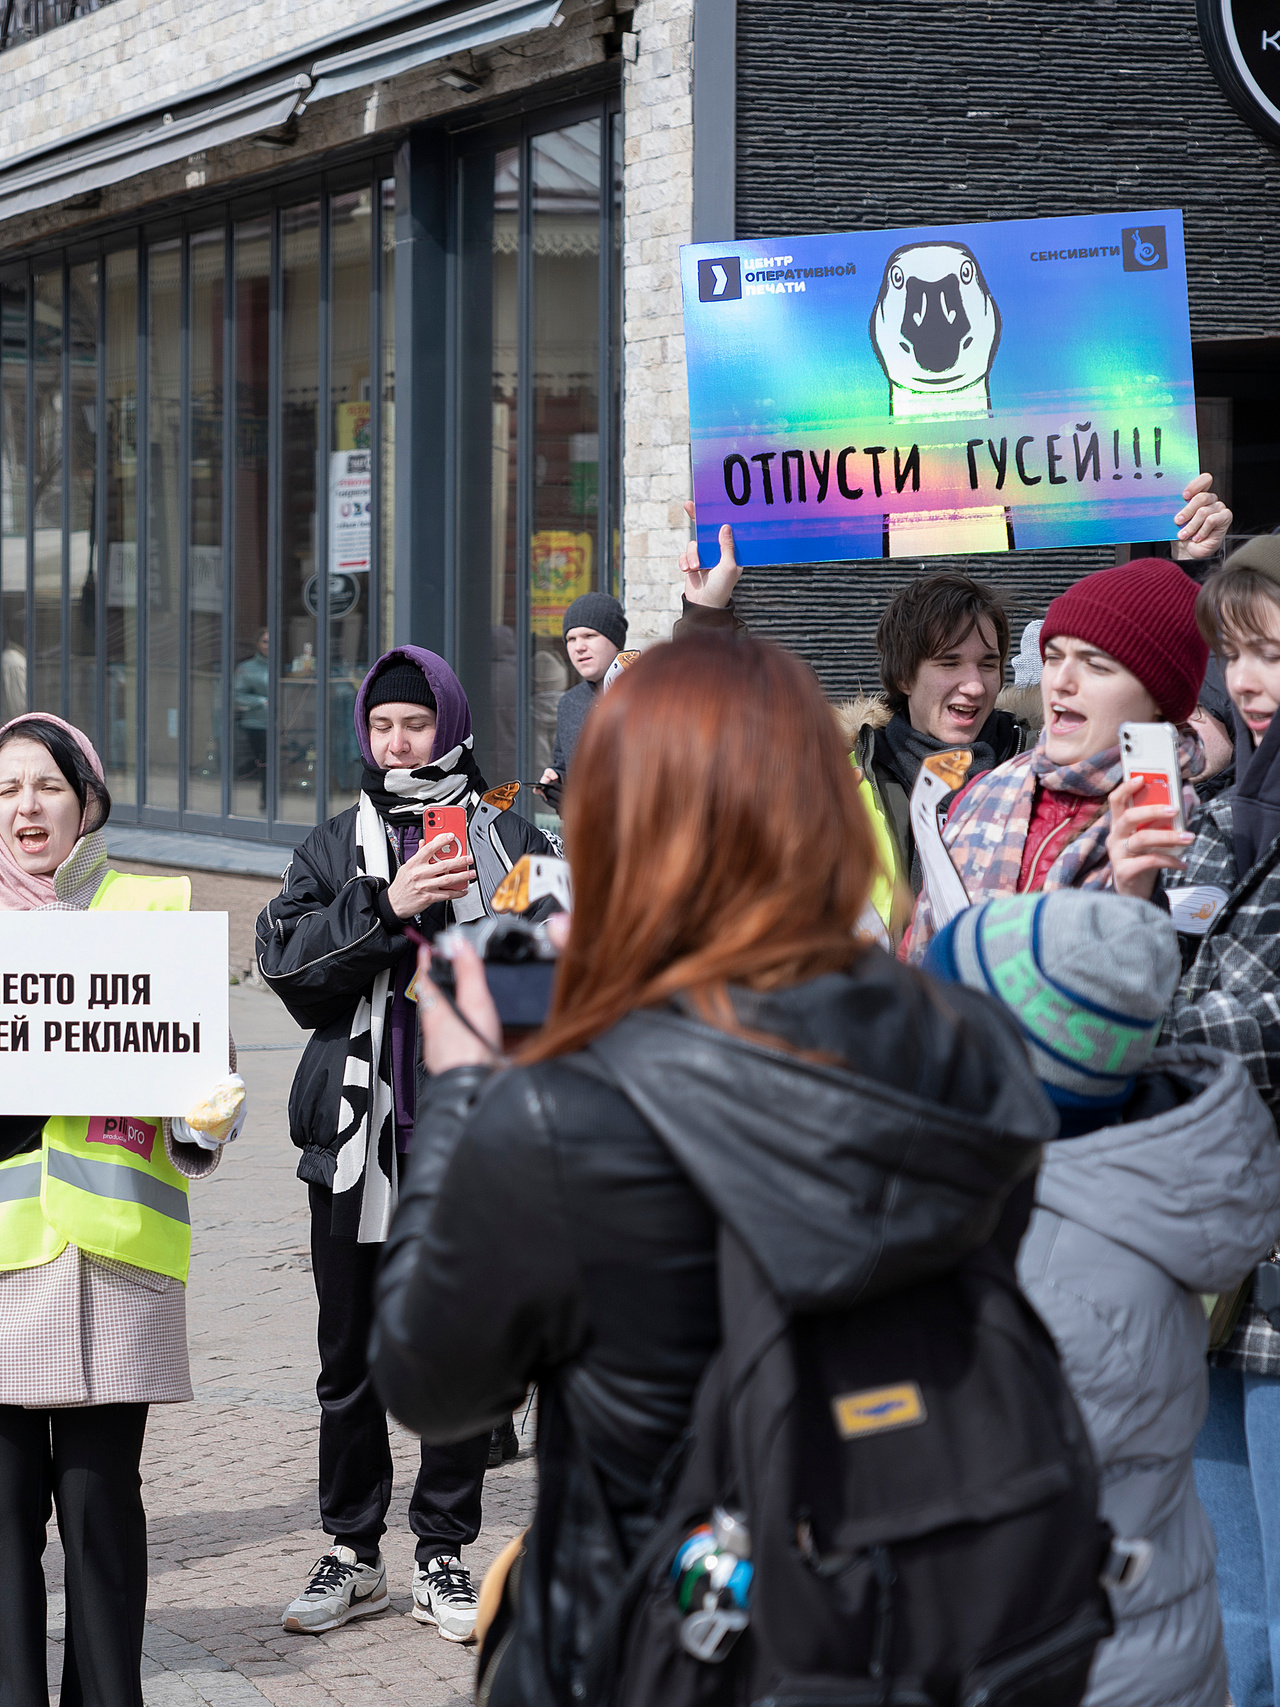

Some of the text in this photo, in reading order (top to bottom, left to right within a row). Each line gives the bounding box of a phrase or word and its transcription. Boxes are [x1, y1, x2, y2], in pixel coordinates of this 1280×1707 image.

[743, 255, 794, 271] ЦЕНТР
[1029, 245, 1121, 262] СЕНСИВИТИ
[744, 262, 857, 283] ОПЕРАТИВНОЙ
[745, 280, 807, 297] ПЕЧАТИ
[723, 421, 1164, 507] ОТПУСТИ ГУСЕЙ!!!
[88, 973, 151, 1009] ДЛЯ
[991, 948, 1144, 1073] BEST
[44, 1020, 200, 1053] РЕКЛАМЫ
[127, 1125, 145, 1145] pro
